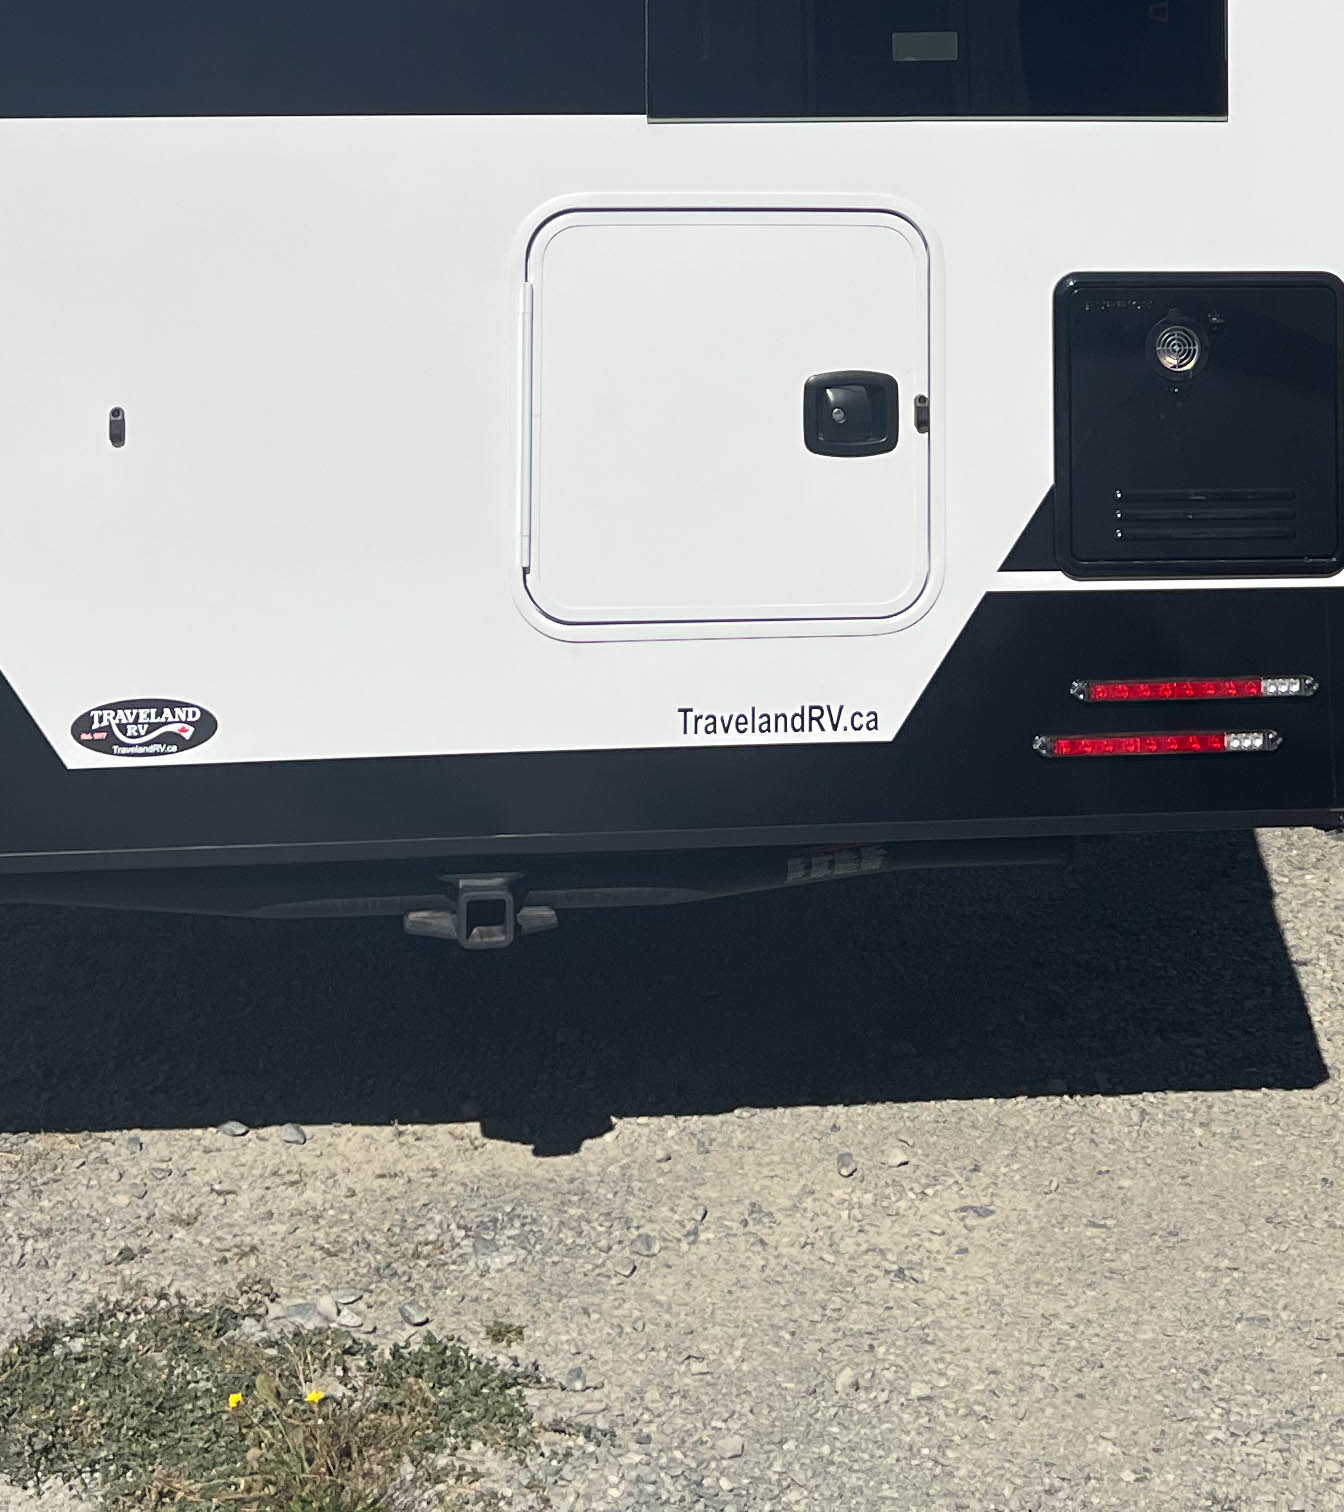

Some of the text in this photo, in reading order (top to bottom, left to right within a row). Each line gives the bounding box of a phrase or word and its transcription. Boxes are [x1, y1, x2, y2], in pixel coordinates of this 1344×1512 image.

[89, 706, 202, 731] TRAVELAND
[126, 724, 150, 737] RV
[676, 704, 880, 735] TravelandRV.ca
